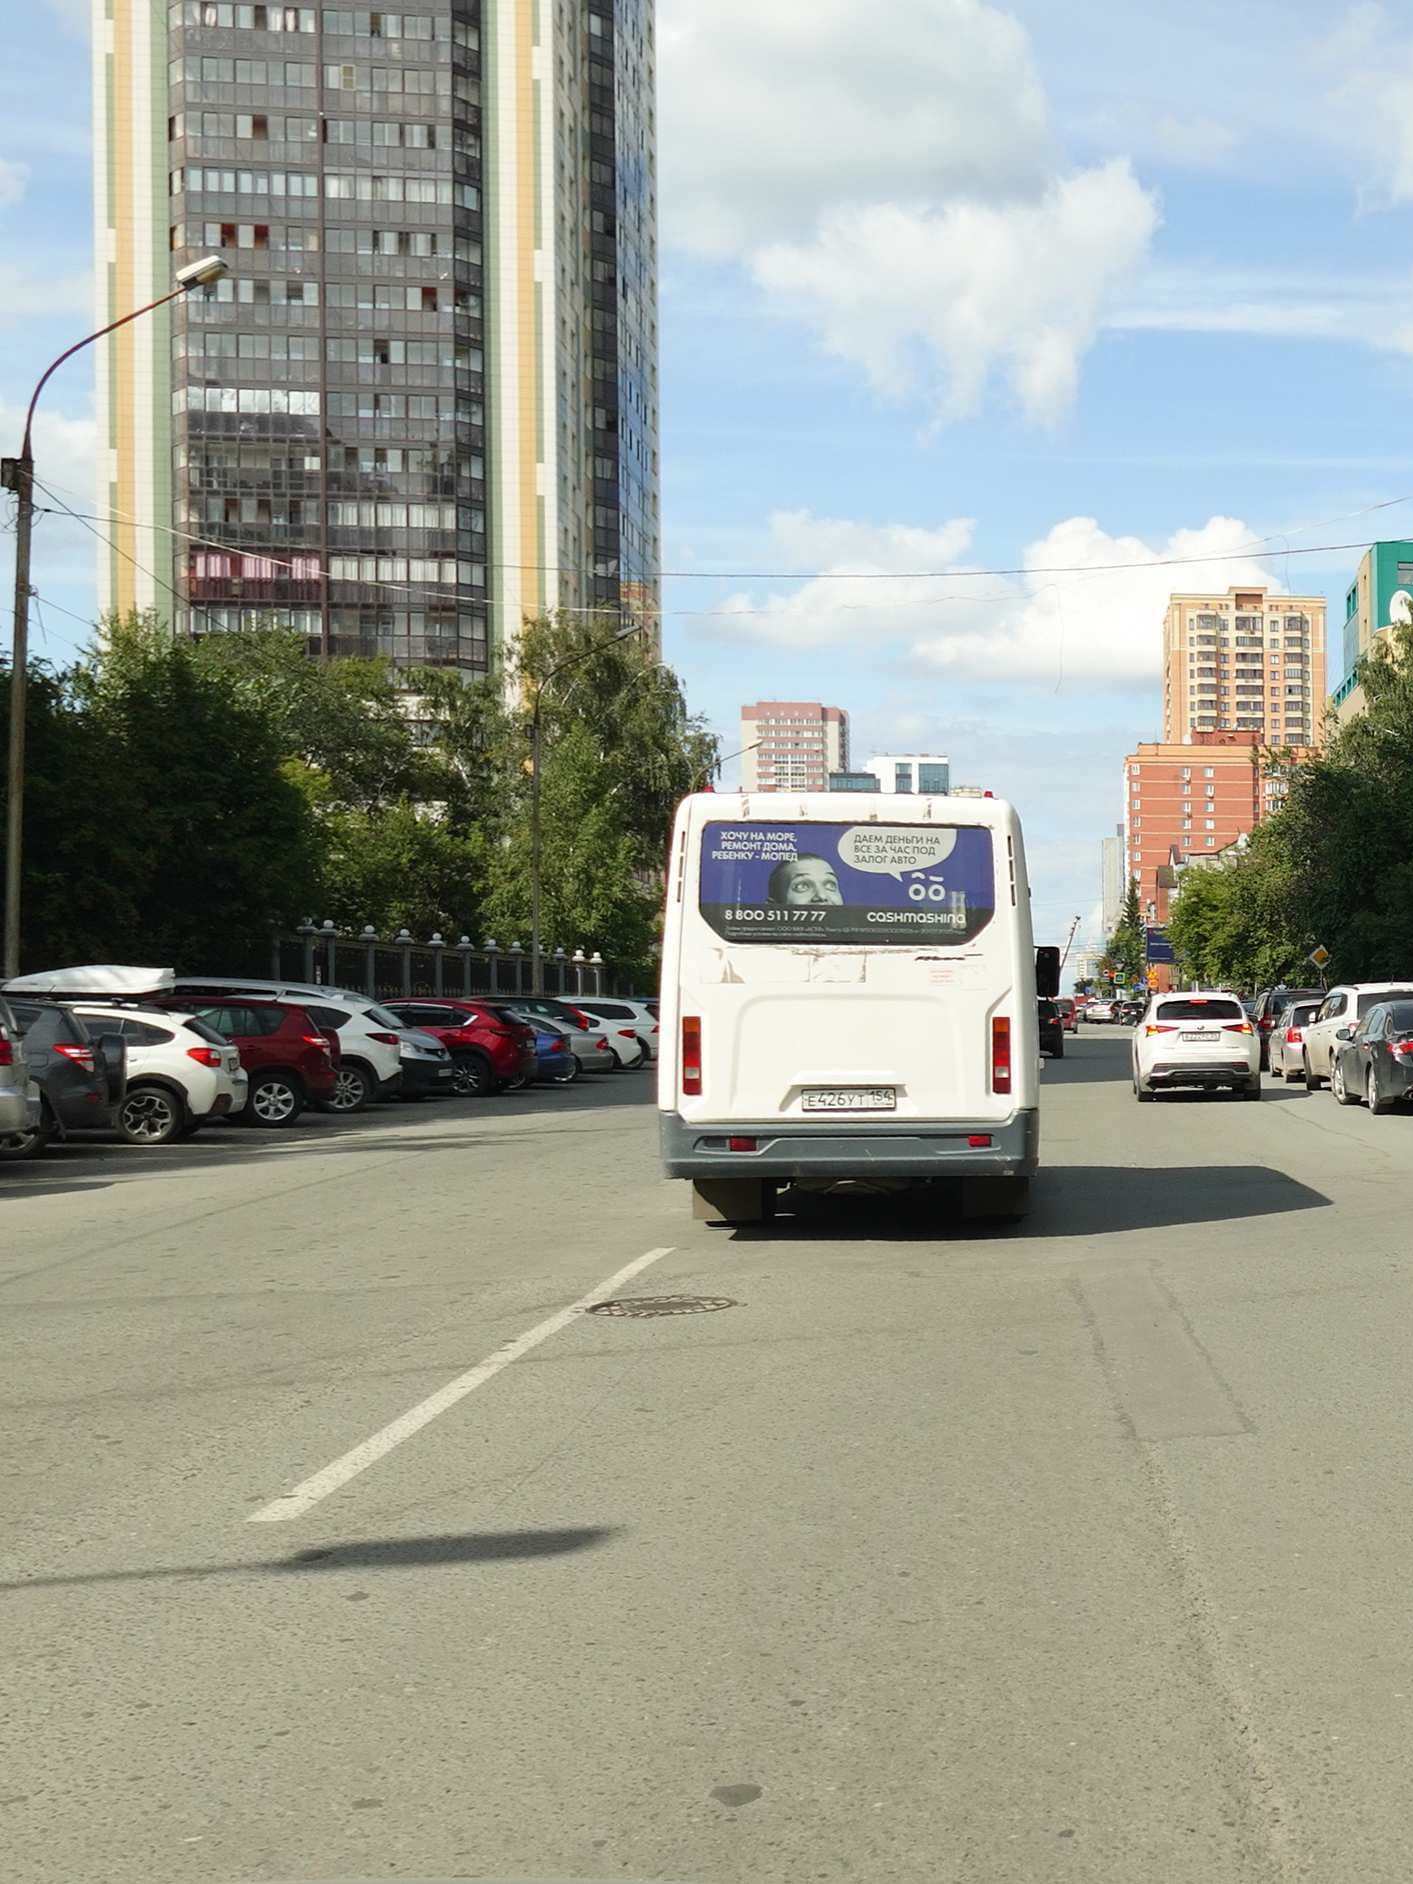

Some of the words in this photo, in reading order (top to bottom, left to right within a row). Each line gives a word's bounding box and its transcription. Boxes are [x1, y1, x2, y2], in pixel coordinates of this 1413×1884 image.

[720, 831, 750, 841] ХОЧУ
[750, 832, 765, 841] НА
[766, 832, 798, 842] МОРЕ,
[854, 834, 883, 844] ДАЕМ
[885, 835, 924, 845] ДЕНЬГИ
[925, 836, 941, 845] НА
[721, 841, 762, 850] РЕМОНТ
[854, 844, 874, 854] ВСЕ
[874, 845, 888, 854] ЗА
[889, 845, 911, 855] ЧАС
[912, 846, 936, 856] ПОД
[711, 850, 754, 860] РЕБЕНКУ
[761, 852, 798, 862] МОПЕД
[854, 854, 889, 864] ЗАЛОГ
[890, 855, 917, 865] АВТО
[724, 910, 733, 920] 8
[735, 910, 765, 921] 800
[767, 911, 789, 921] 511
[792, 911, 809, 921] 77
[810, 911, 827, 921] 77
